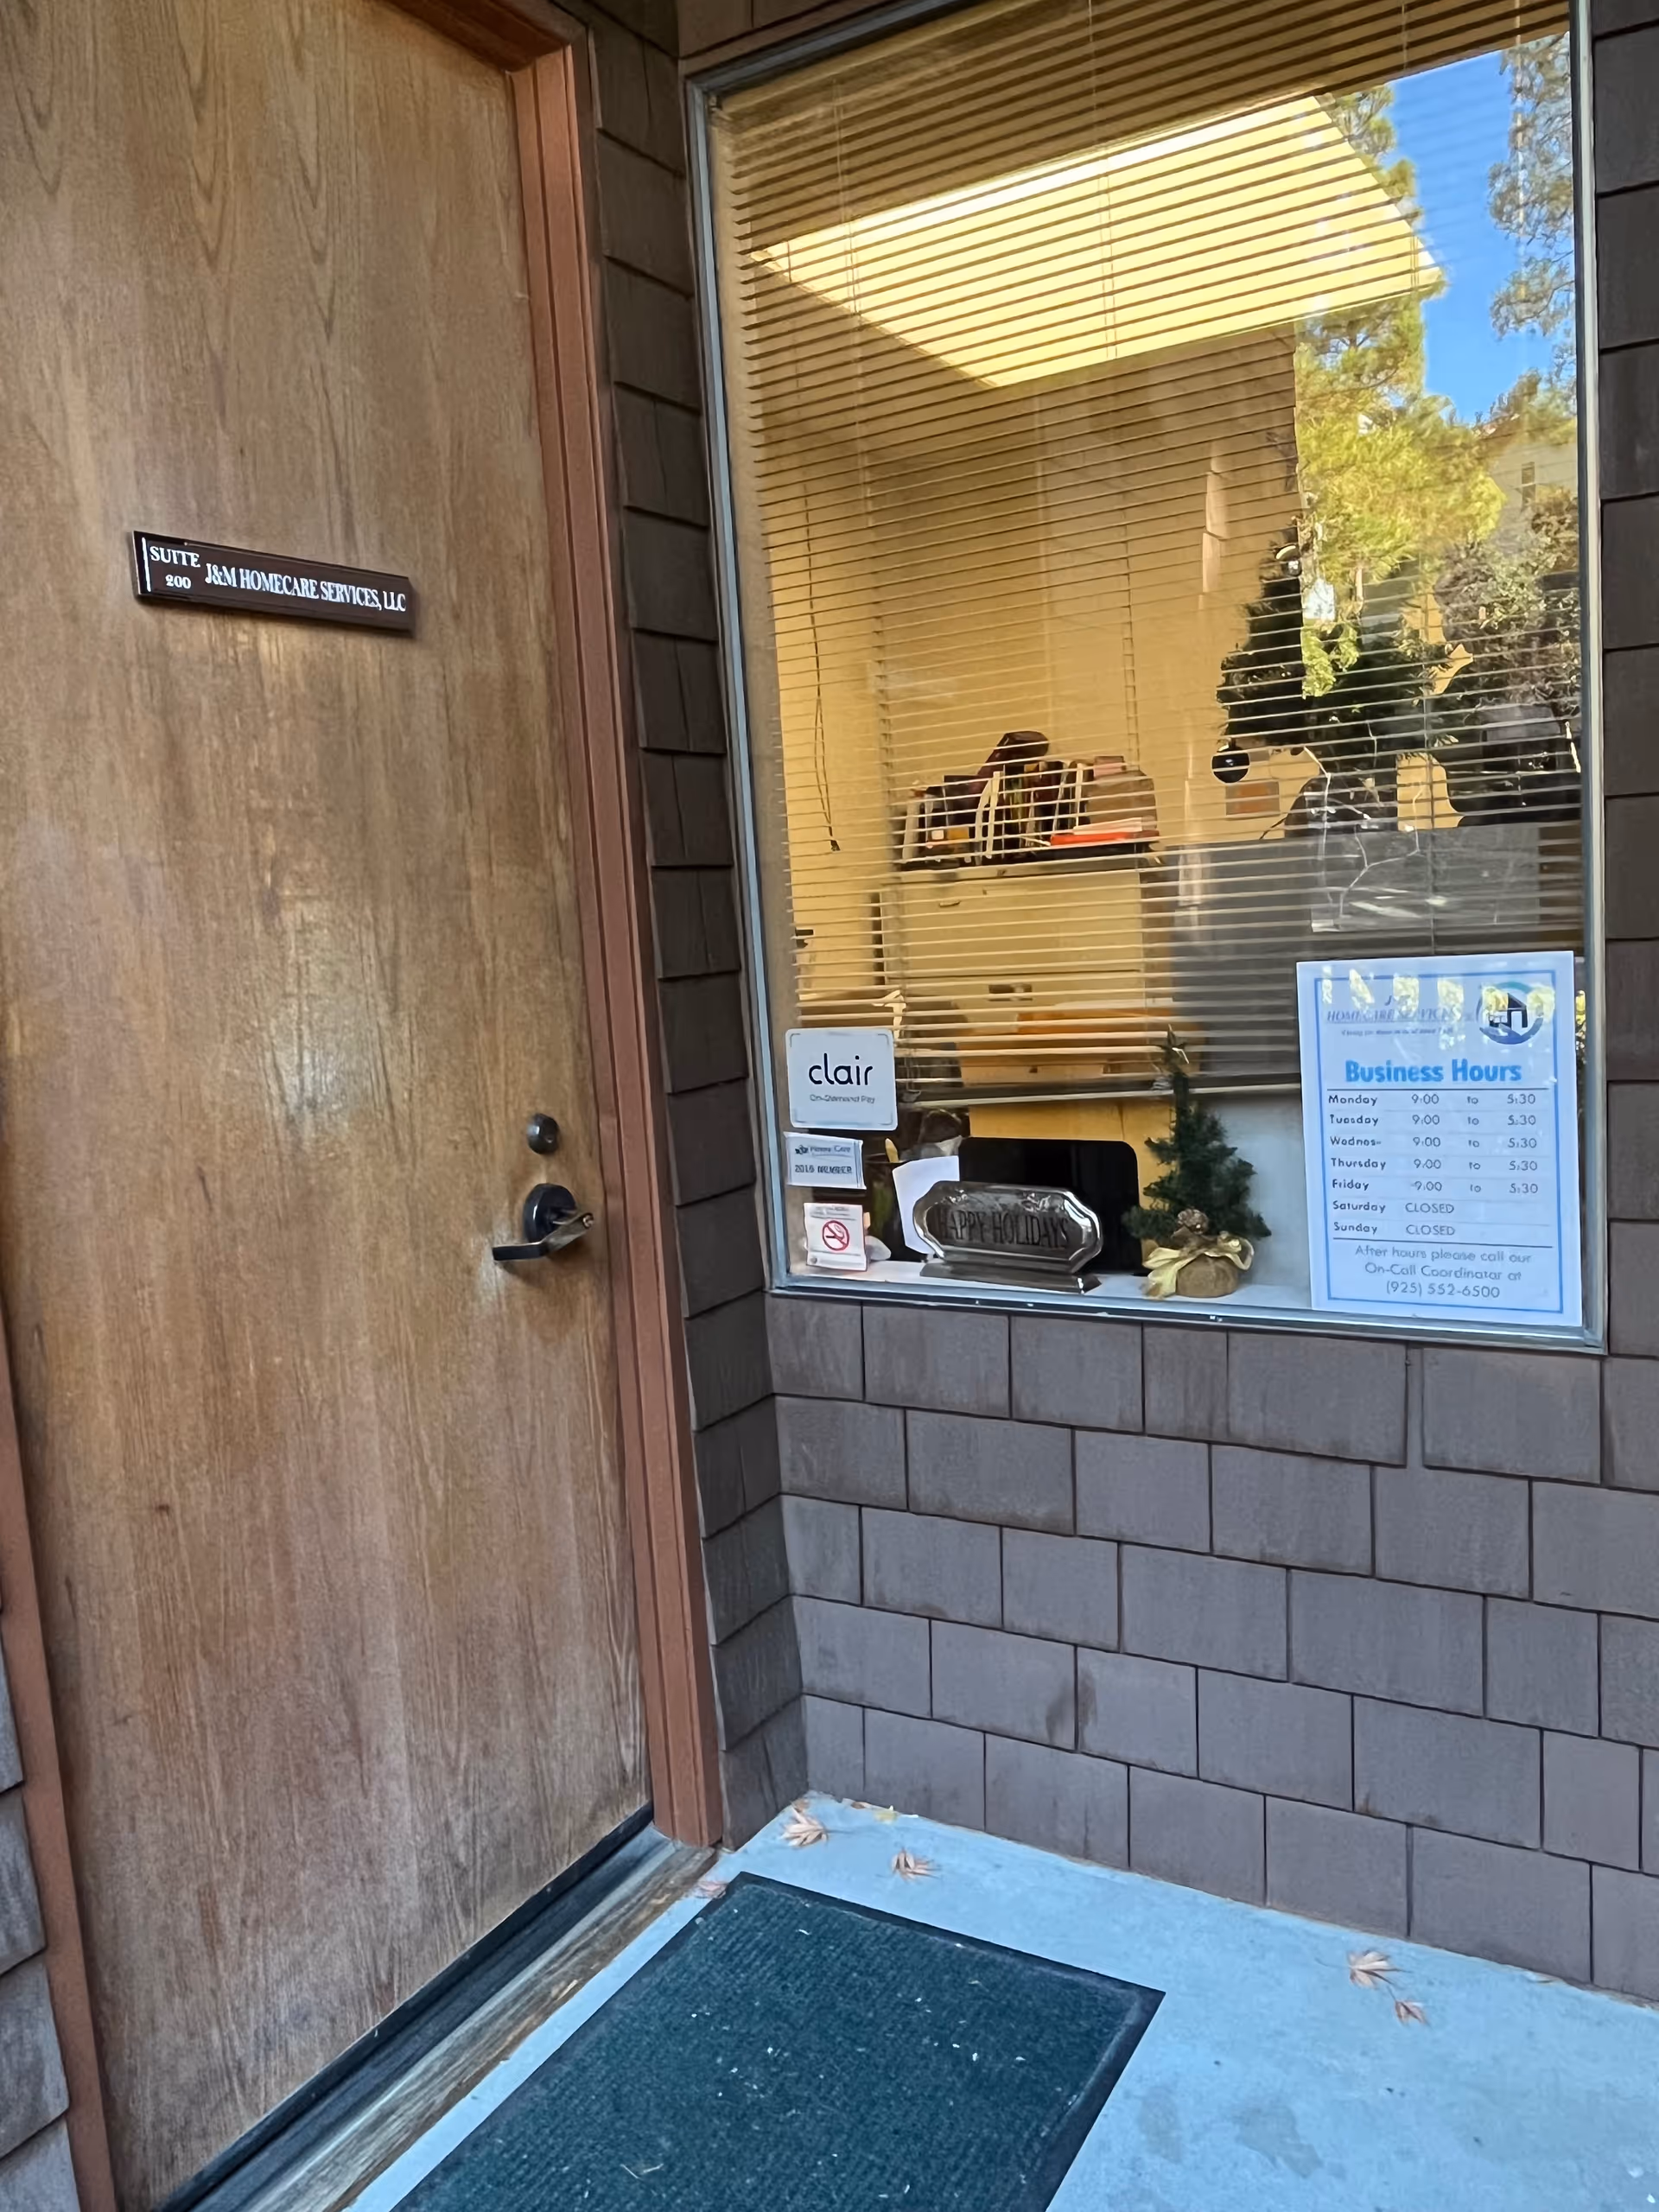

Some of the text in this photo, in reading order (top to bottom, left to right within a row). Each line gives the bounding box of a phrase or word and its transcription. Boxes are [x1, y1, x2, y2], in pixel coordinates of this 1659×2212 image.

[149, 545, 200, 568] SUITE
[165, 574, 192, 589] 200
[205, 563, 406, 612] J&M HOMECARE SERVICES, LLC
[808, 1052, 874, 1086] clair
[1345, 1058, 1522, 1083] Business Hours
[1328, 1094, 1536, 1107] Monday 9:00 to 5:30
[1330, 1114, 1536, 1126] Tuesday 9:00 to 5:30
[1413, 1136, 1441, 1147] 9:00
[1468, 1139, 1480, 1148] to
[1508, 1137, 1537, 1148] 5:30
[1331, 1158, 1538, 1171] Thursday 9:00 to 5:30
[1332, 1179, 1539, 1194] Friday 9:00 to 5:30
[1332, 1200, 1455, 1214] Saturday CLOSED
[992, 1208, 1069, 1249] HOLIDAYS
[1333, 1221, 1456, 1236] Sunday CLOSED
[1355, 1245, 1533, 1263] After hours please call our
[1364, 1262, 1522, 1281] On-Call Coordinator at
[1386, 1280, 1500, 1299] (925) 552-6500
